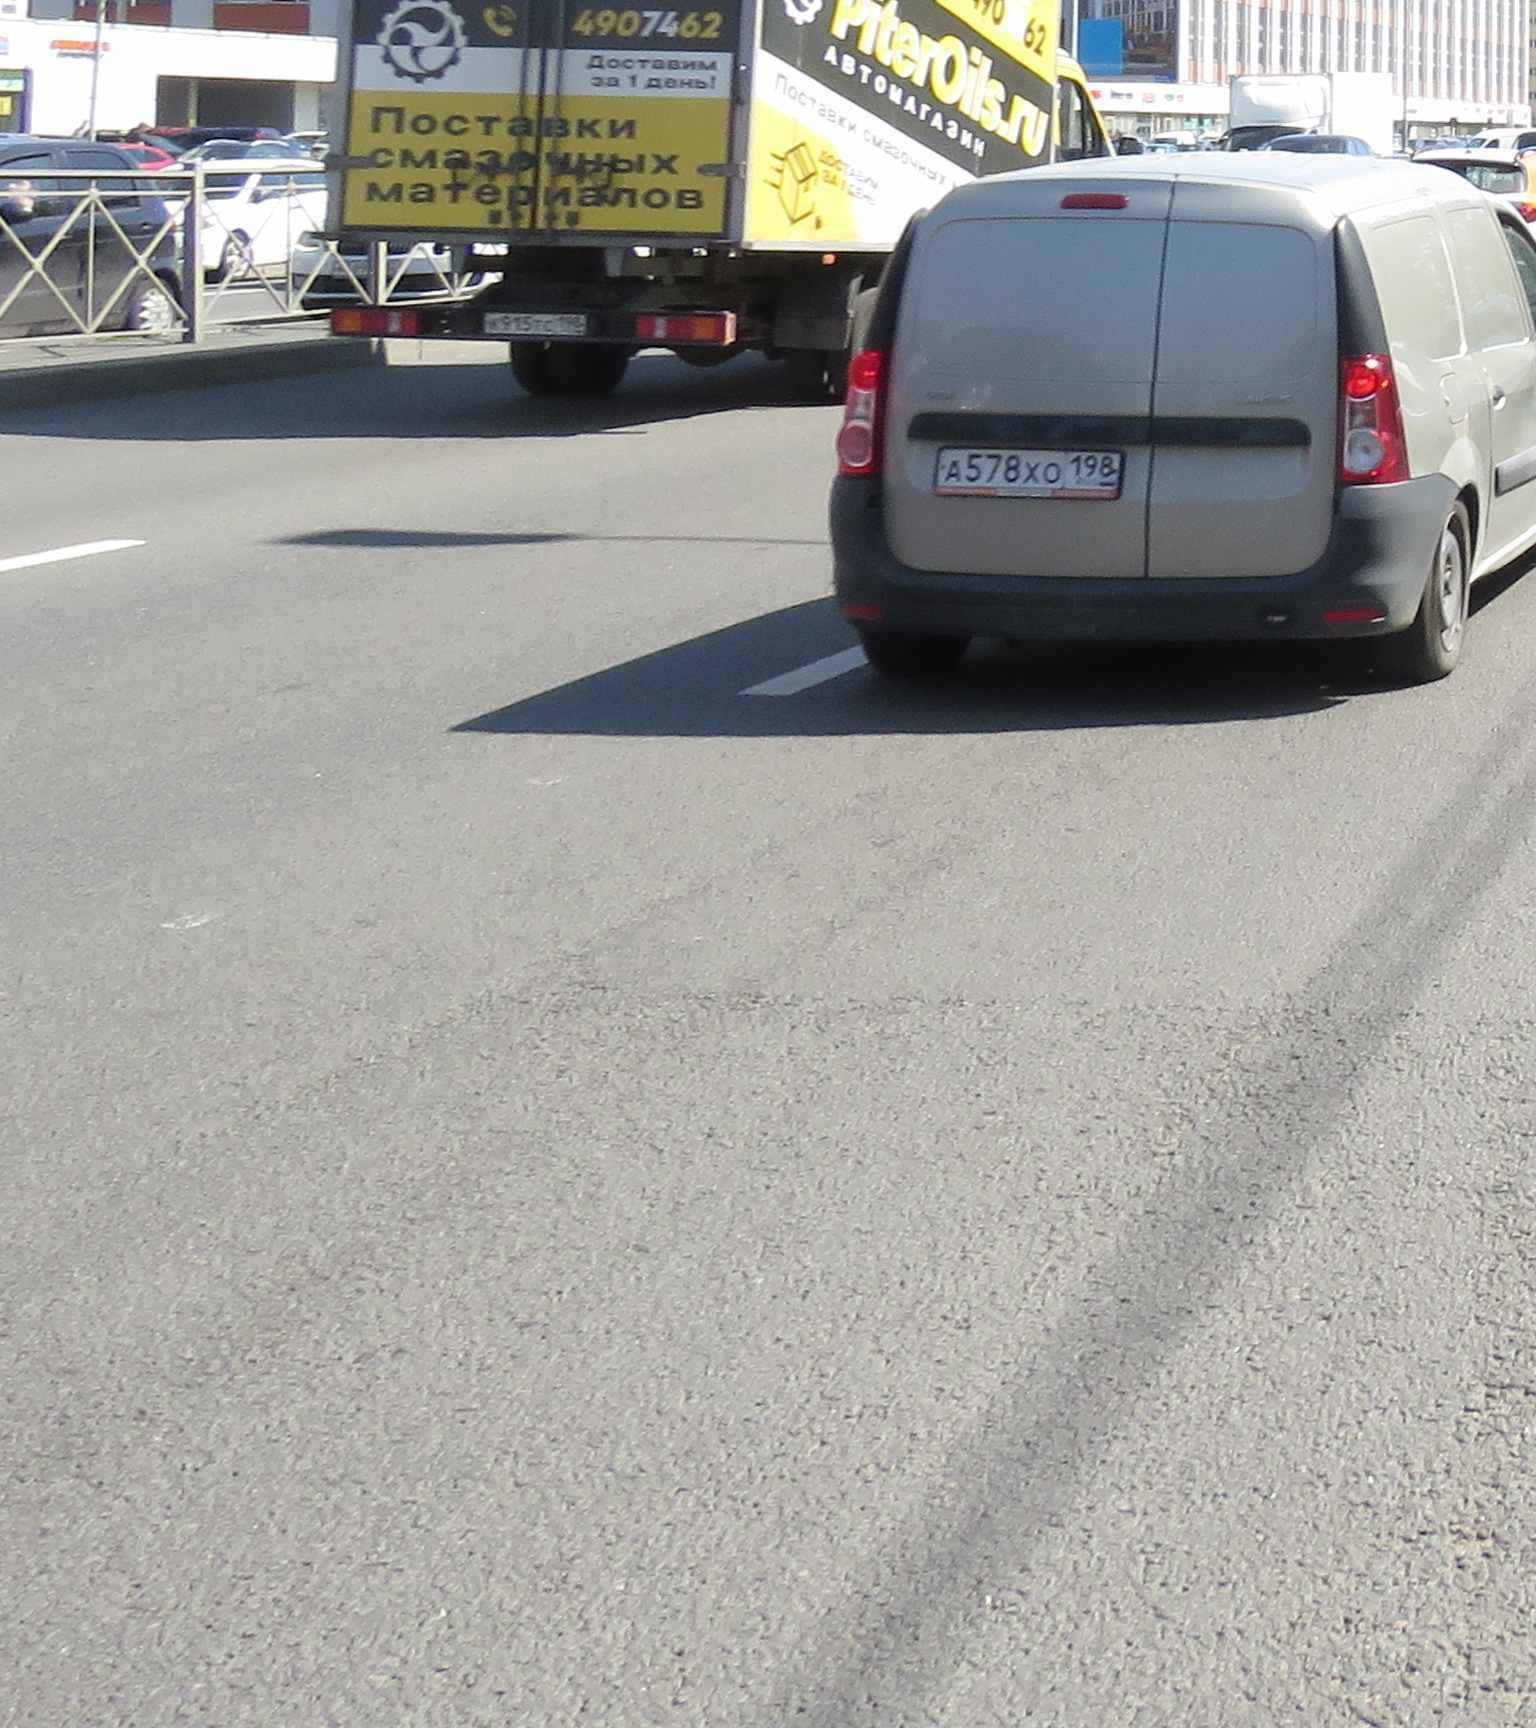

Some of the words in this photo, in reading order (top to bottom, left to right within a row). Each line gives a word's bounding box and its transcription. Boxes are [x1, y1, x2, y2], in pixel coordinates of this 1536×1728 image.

[572, 9, 724, 39] 4907462
[586, 55, 717, 72] Доставим
[590, 76, 618, 88] за
[627, 75, 636, 88] 1
[643, 74, 716, 90] день!
[775, 73, 857, 135] Поставки
[823, 45, 986, 158] АВТОМАГАЗИН
[370, 106, 636, 139] Поставки
[370, 147, 680, 176] смазочных
[365, 181, 705, 210] материалов
[1069, 455, 1117, 476] 198
